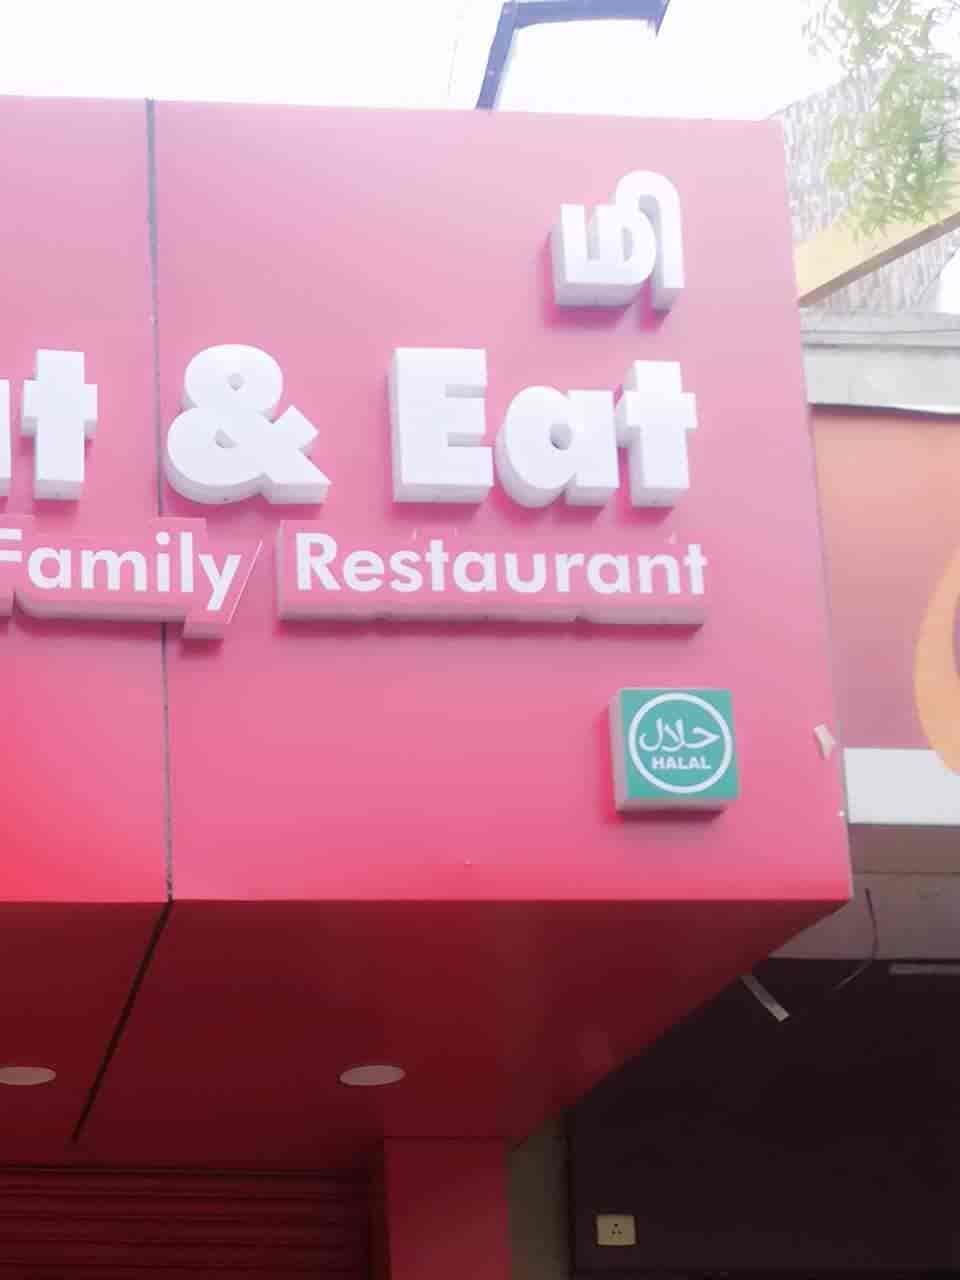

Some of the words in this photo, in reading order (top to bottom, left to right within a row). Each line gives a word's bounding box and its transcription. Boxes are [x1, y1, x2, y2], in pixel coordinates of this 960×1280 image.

[167, 343, 331, 496] &
[392, 346, 698, 495] Eat
[295, 532, 708, 596] Restaurant
[651, 755, 712, 770] HALAL
